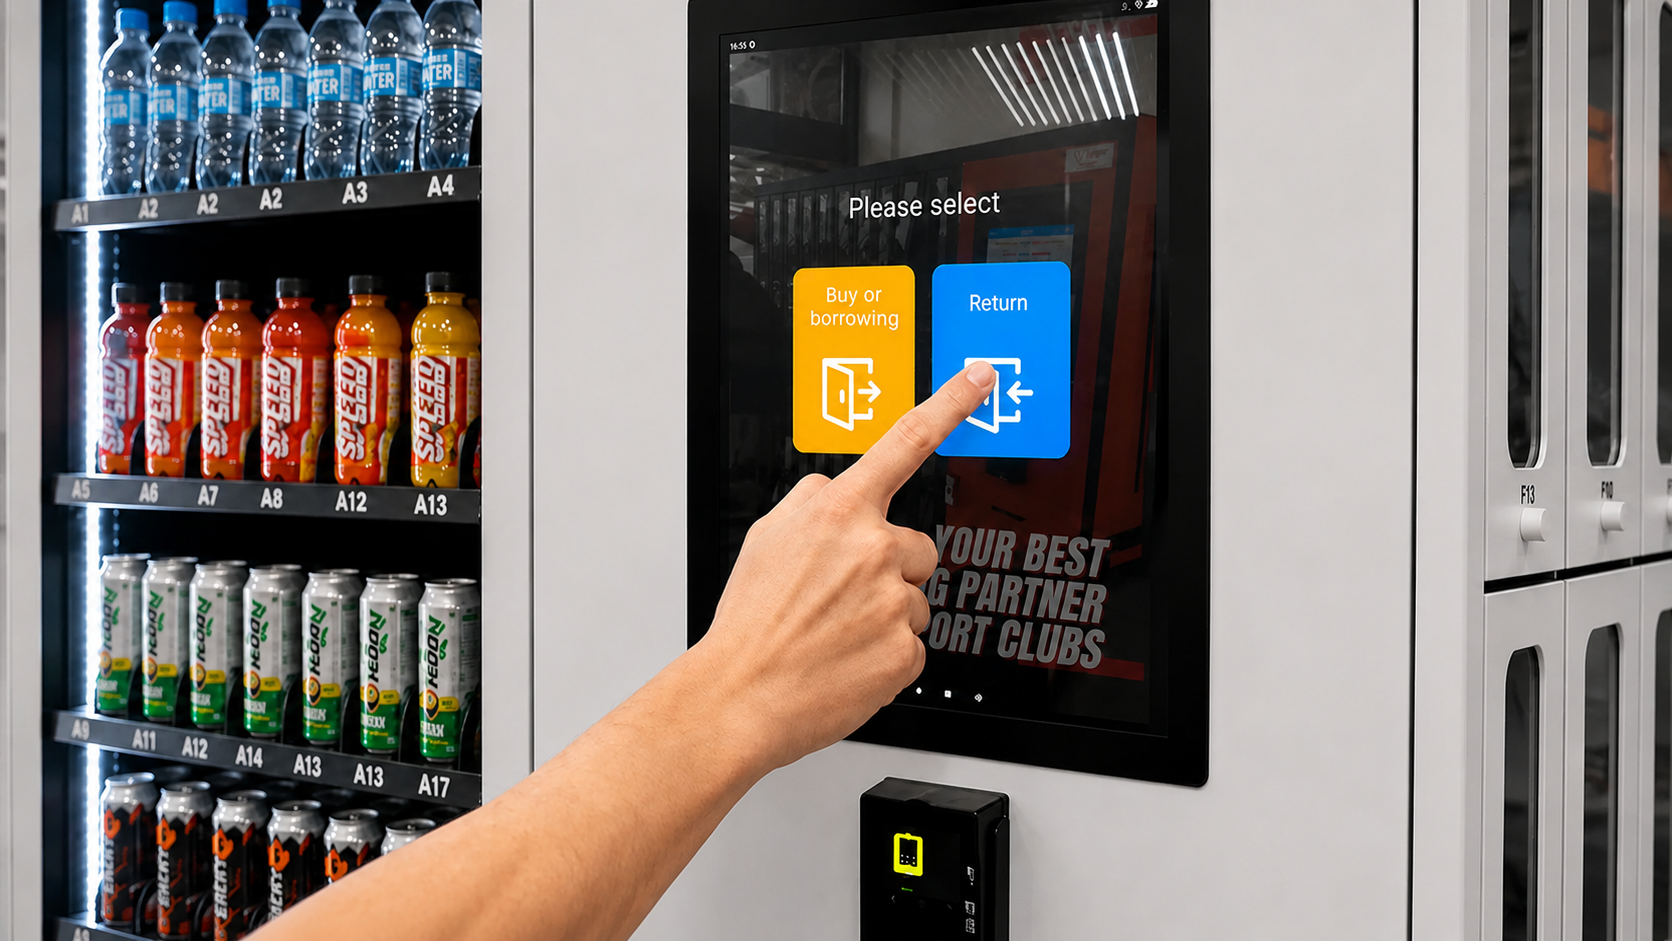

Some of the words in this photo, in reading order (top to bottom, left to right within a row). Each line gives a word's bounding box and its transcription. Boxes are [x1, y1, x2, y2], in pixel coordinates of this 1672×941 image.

[71, 203, 89, 224] A1
[138, 197, 159, 219] A2
[197, 193, 219, 215] A2
[259, 187, 283, 211] A2
[342, 181, 368, 205] A3
[427, 174, 455, 198] A4
[849, 195, 923, 219] Please
[930, 191, 1001, 216] select
[826, 286, 858, 307] Buy
[863, 289, 882, 303] or
[969, 294, 1028, 312] Return
[810, 309, 899, 331] borrowing
[72, 480, 91, 499] A5
[138, 482, 159, 503] A6
[197, 484, 219, 506] A7
[260, 487, 283, 509] A8
[335, 490, 368, 513] A12
[413, 493, 448, 516] A13
[1520, 484, 1536, 504] F13
[935, 524, 1017, 569] YOUR
[1023, 532, 1111, 578] BEST
[956, 570, 1108, 624] PARTNER
[997, 619, 1106, 669] CLUBS
[71, 719, 90, 740] A9
[131, 728, 156, 754] A11
[181, 736, 208, 760] A12
[235, 744, 263, 768] A14
[293, 753, 322, 778] A13
[353, 763, 384, 788] A13
[417, 773, 451, 799] A17
